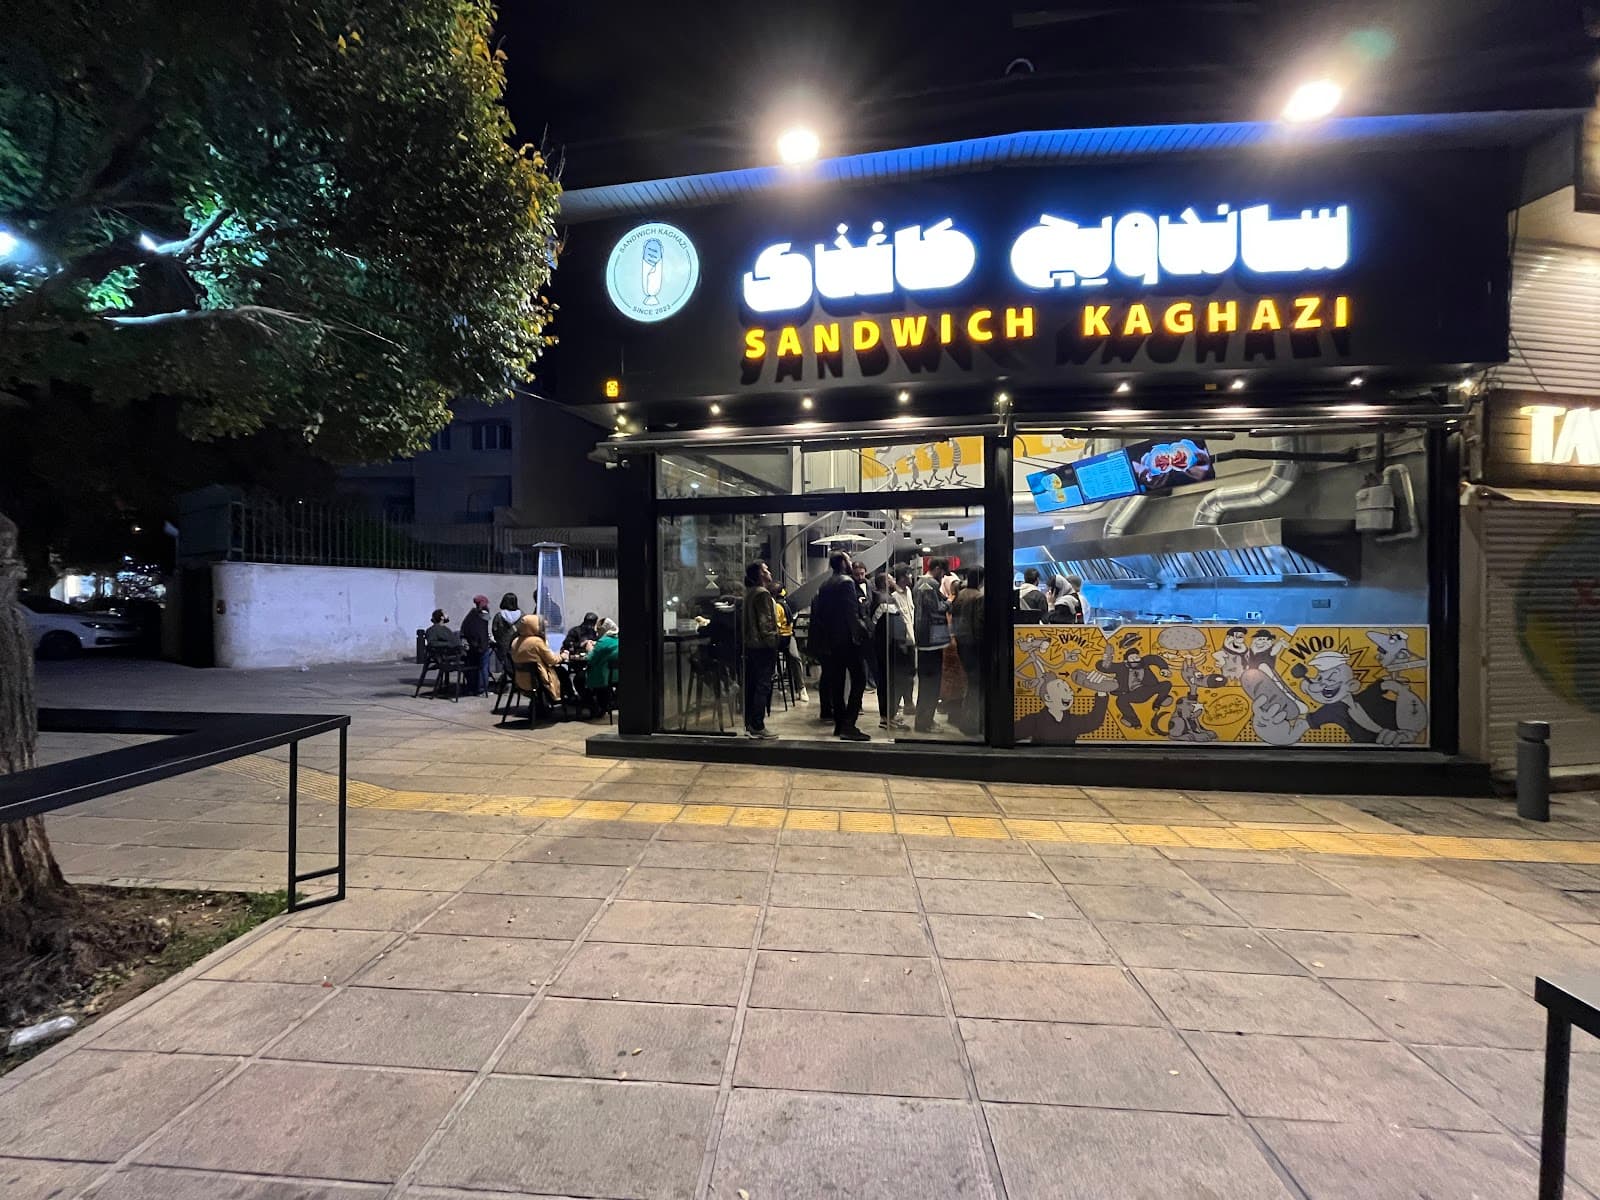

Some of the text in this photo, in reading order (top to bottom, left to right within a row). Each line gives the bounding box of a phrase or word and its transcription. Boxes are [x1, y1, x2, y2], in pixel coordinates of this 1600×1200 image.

[620, 228, 688, 253] SANDWICH KAGHAZI
[632, 305, 653, 316] SINCE
[745, 296, 1348, 359] SANDWICH KAGHAZI
[1519, 405, 1600, 465] TA
[1288, 635, 1334, 660] WOO
